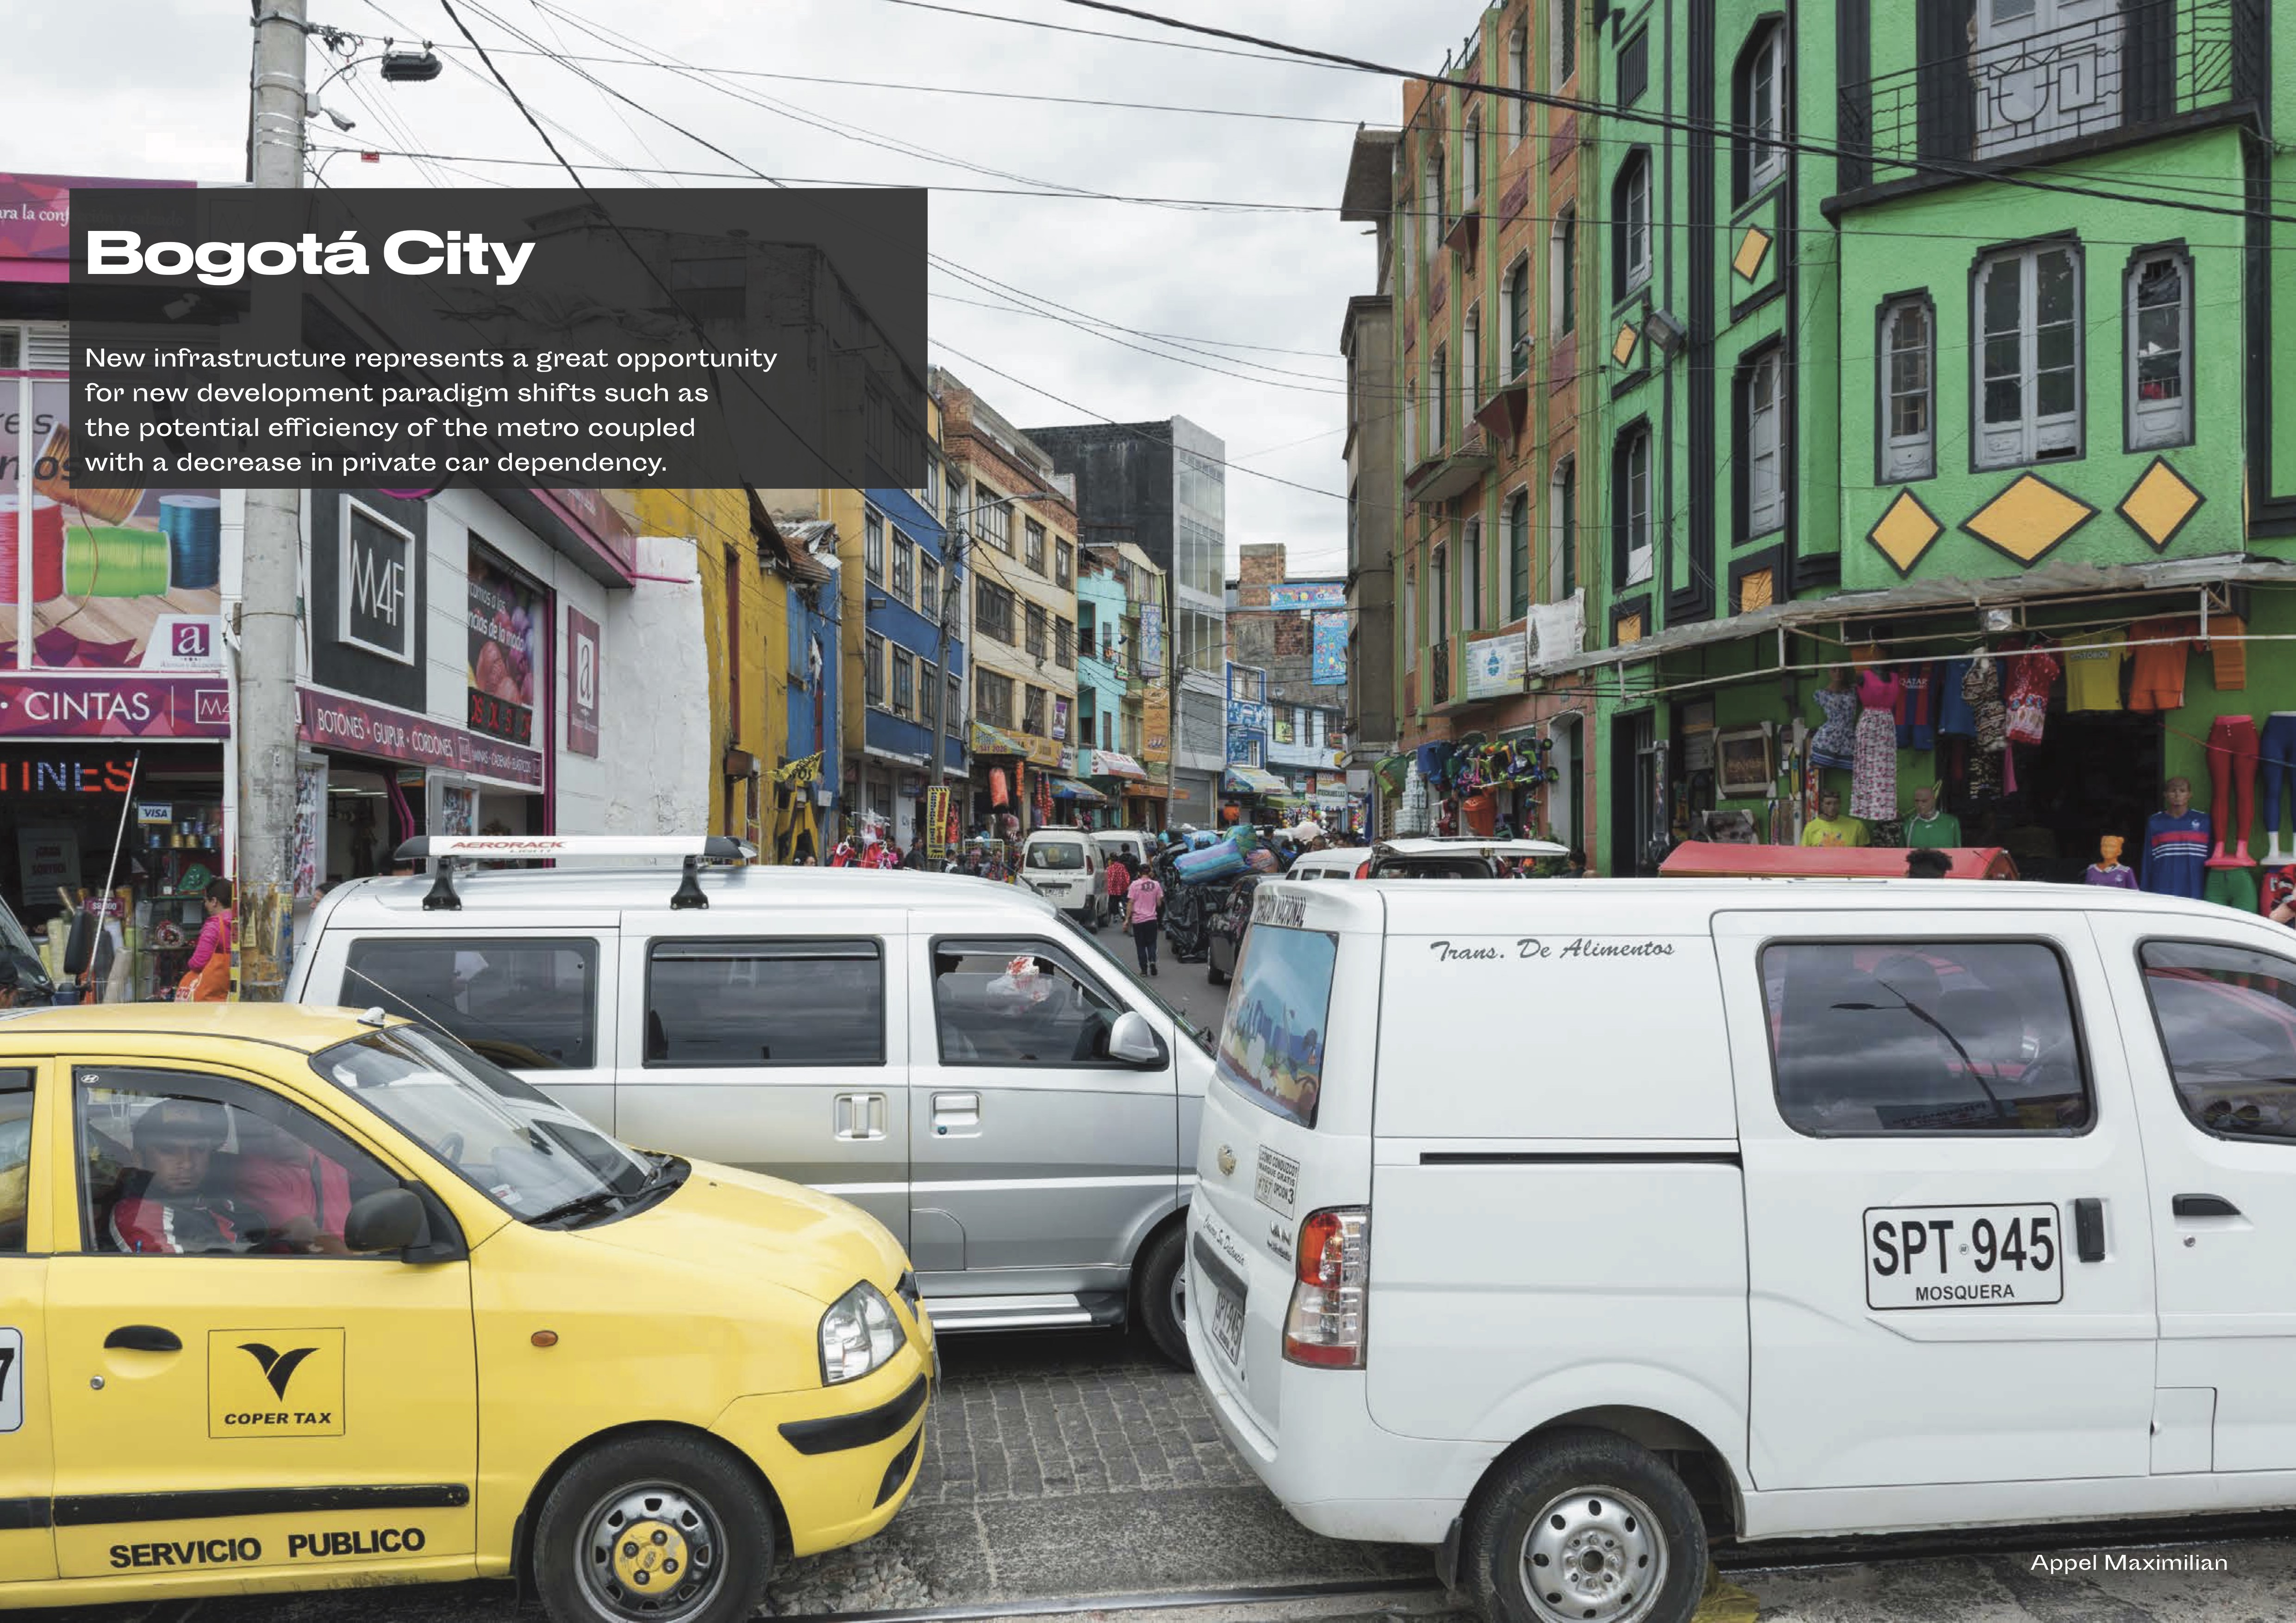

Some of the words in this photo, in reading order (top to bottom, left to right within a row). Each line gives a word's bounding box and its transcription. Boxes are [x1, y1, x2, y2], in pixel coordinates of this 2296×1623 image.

[23, 204, 35, 220] la
[350, 540, 404, 626] M4F
[1900, 678, 1928, 687] QATAR
[25, 691, 150, 721] CINTAS
[317, 709, 365, 740] BOTONES
[373, 722, 406, 748] GUIPUR
[412, 731, 453, 758] CORDONES
[144, 808, 168, 818] VISA
[1430, 940, 1505, 962] Trans.
[1516, 938, 1552, 959] De
[1560, 937, 1676, 959] Alimentos
[1277, 1171, 1295, 1187] GRATIS
[1288, 1188, 1294, 1205] 3
[1872, 1219, 1954, 1276] SPT
[1972, 1217, 2055, 1274] 945
[1915, 1284, 2015, 1301] MOSQUERA
[224, 1412, 289, 1426] COPER
[293, 1412, 332, 1425] TAX
[109, 1536, 262, 1569] SERVICIO
[288, 1527, 425, 1559] PUBLICO
